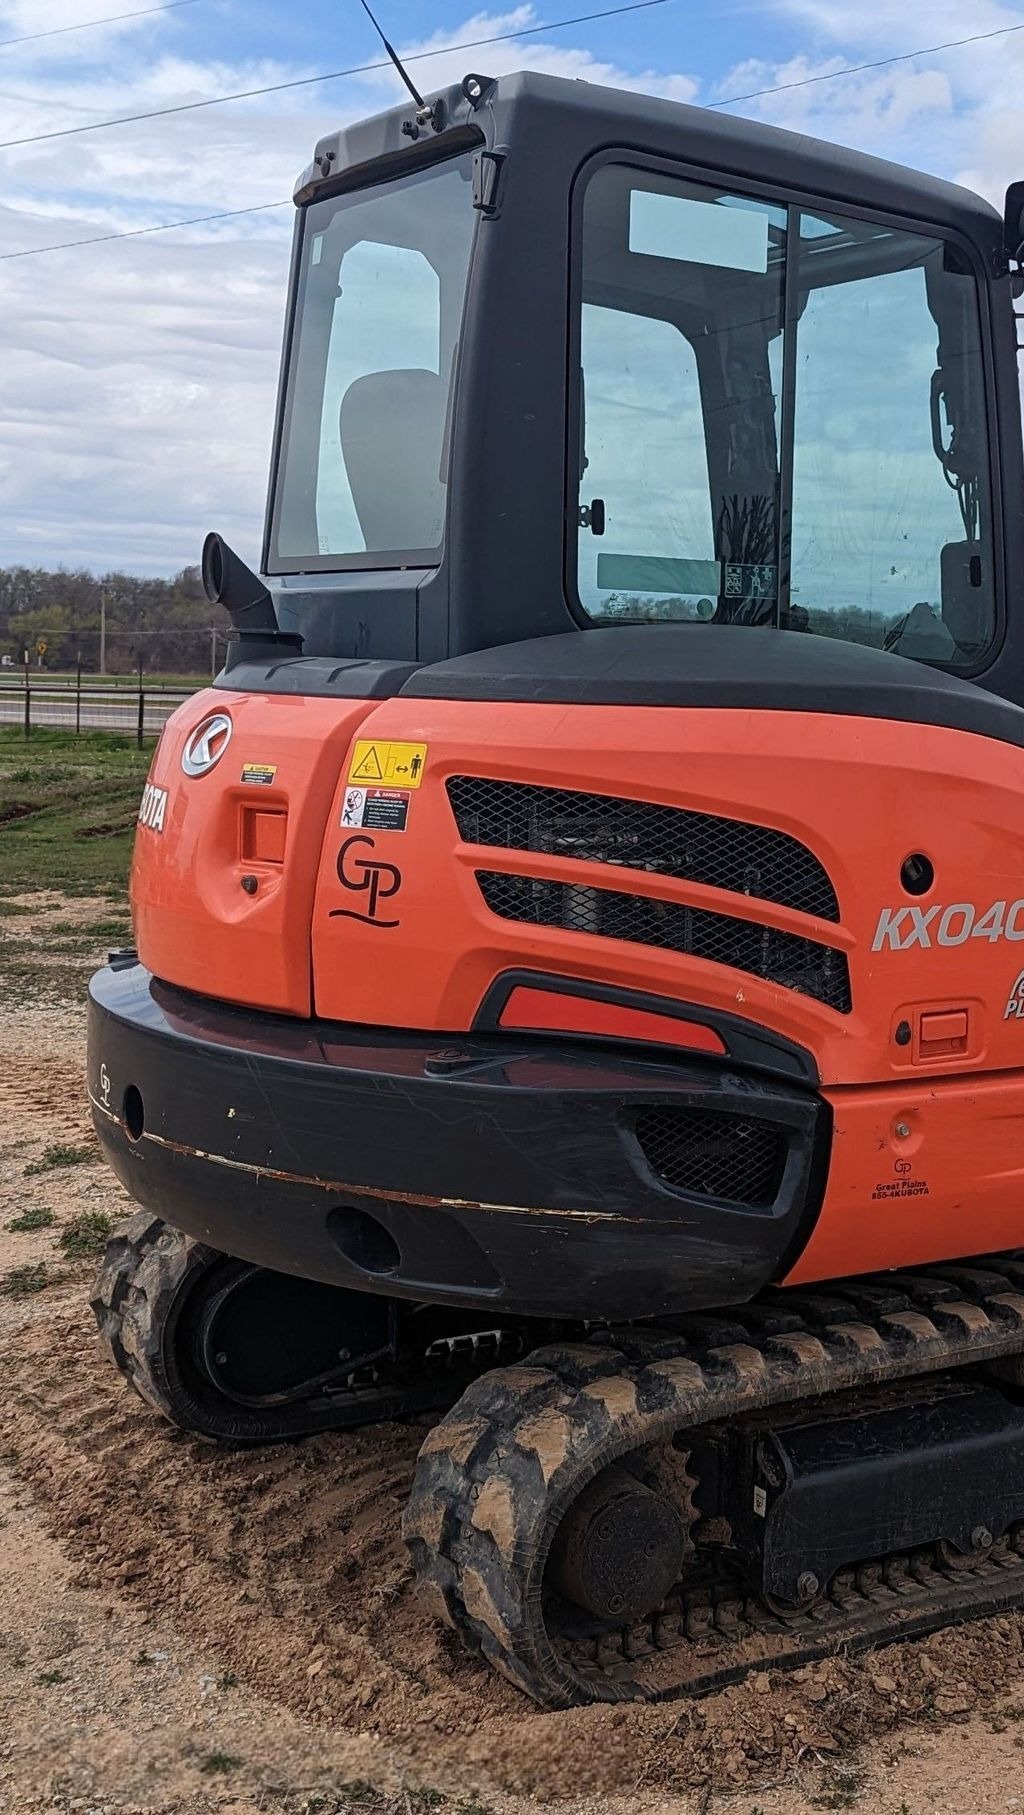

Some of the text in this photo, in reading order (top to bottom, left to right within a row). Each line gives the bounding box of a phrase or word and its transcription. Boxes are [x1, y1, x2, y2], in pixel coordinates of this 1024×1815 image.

[876, 1180, 927, 1192] Great Plains
[872, 1187, 930, 1200] 855-4KUBOTA
